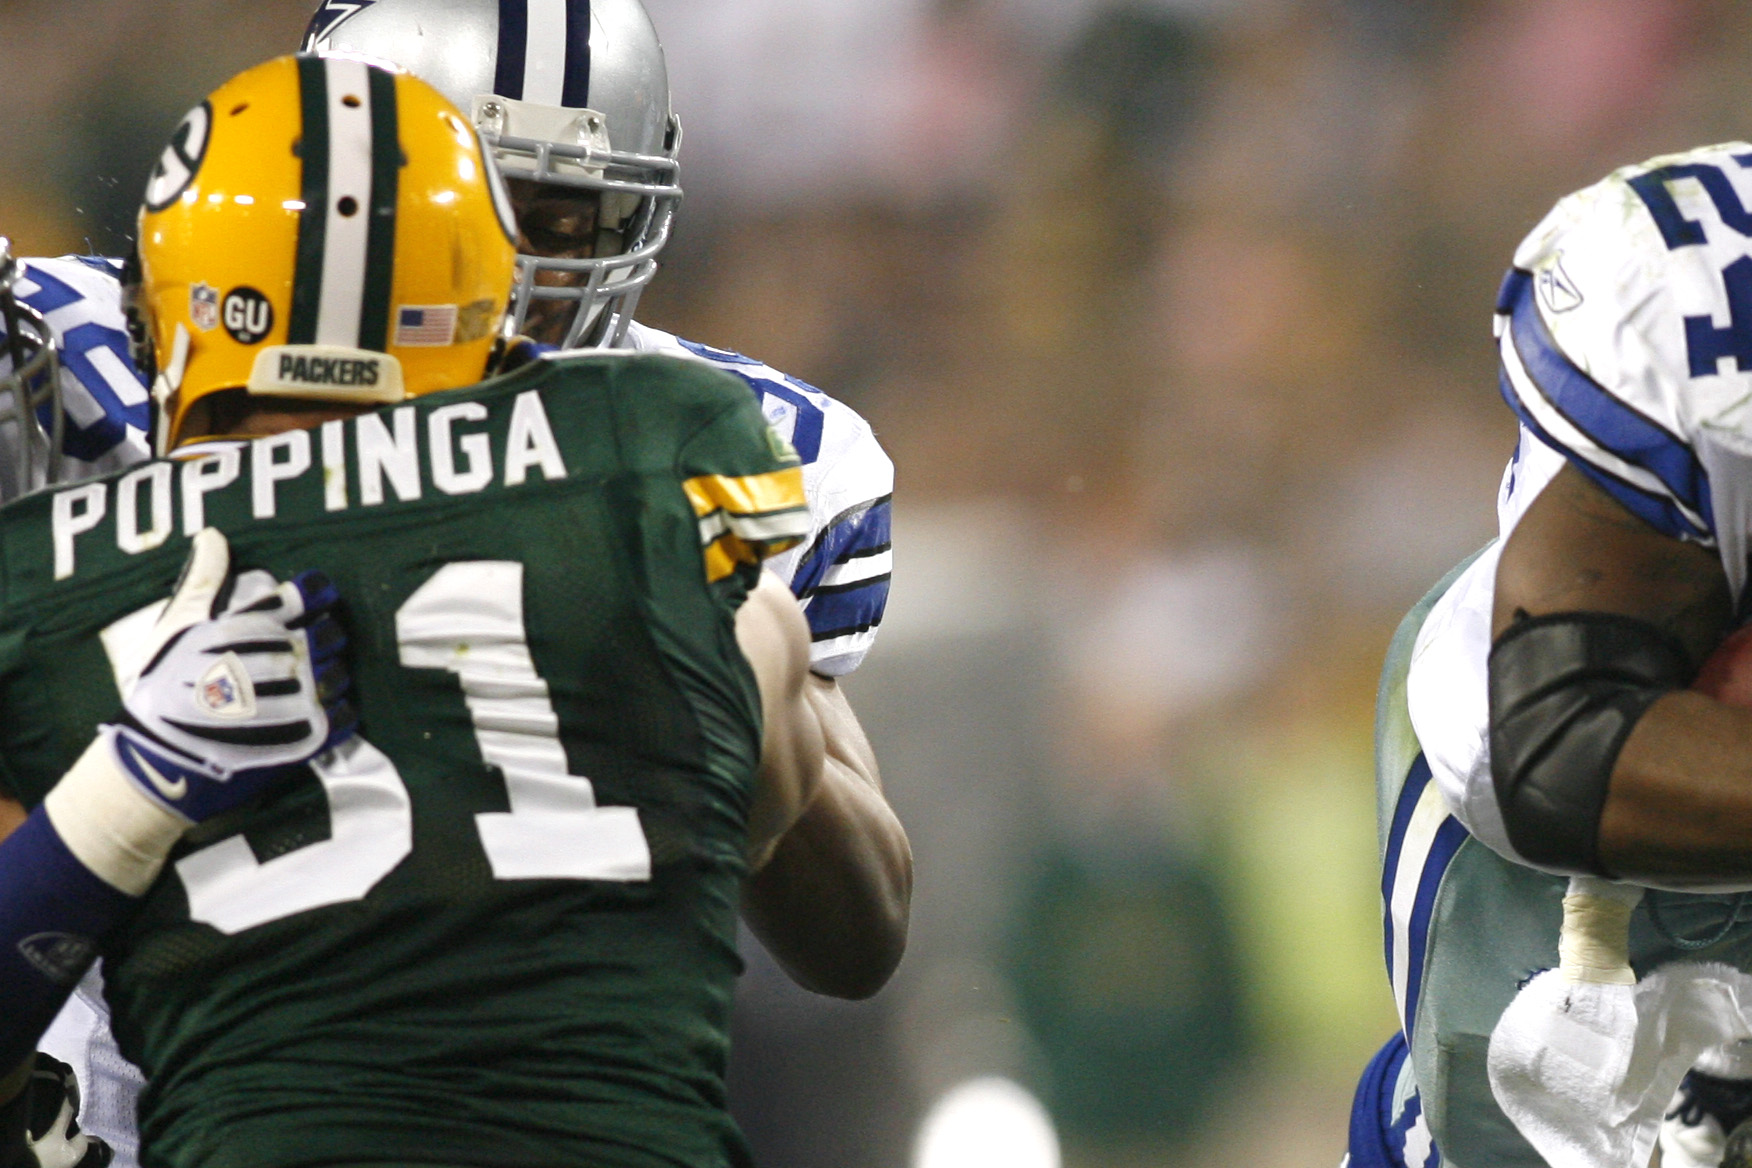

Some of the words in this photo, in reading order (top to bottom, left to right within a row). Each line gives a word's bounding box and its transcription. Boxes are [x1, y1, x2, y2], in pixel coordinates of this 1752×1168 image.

[224, 295, 269, 335] GU
[278, 353, 381, 387] PACKERS
[51, 389, 570, 582] POPPINGA
